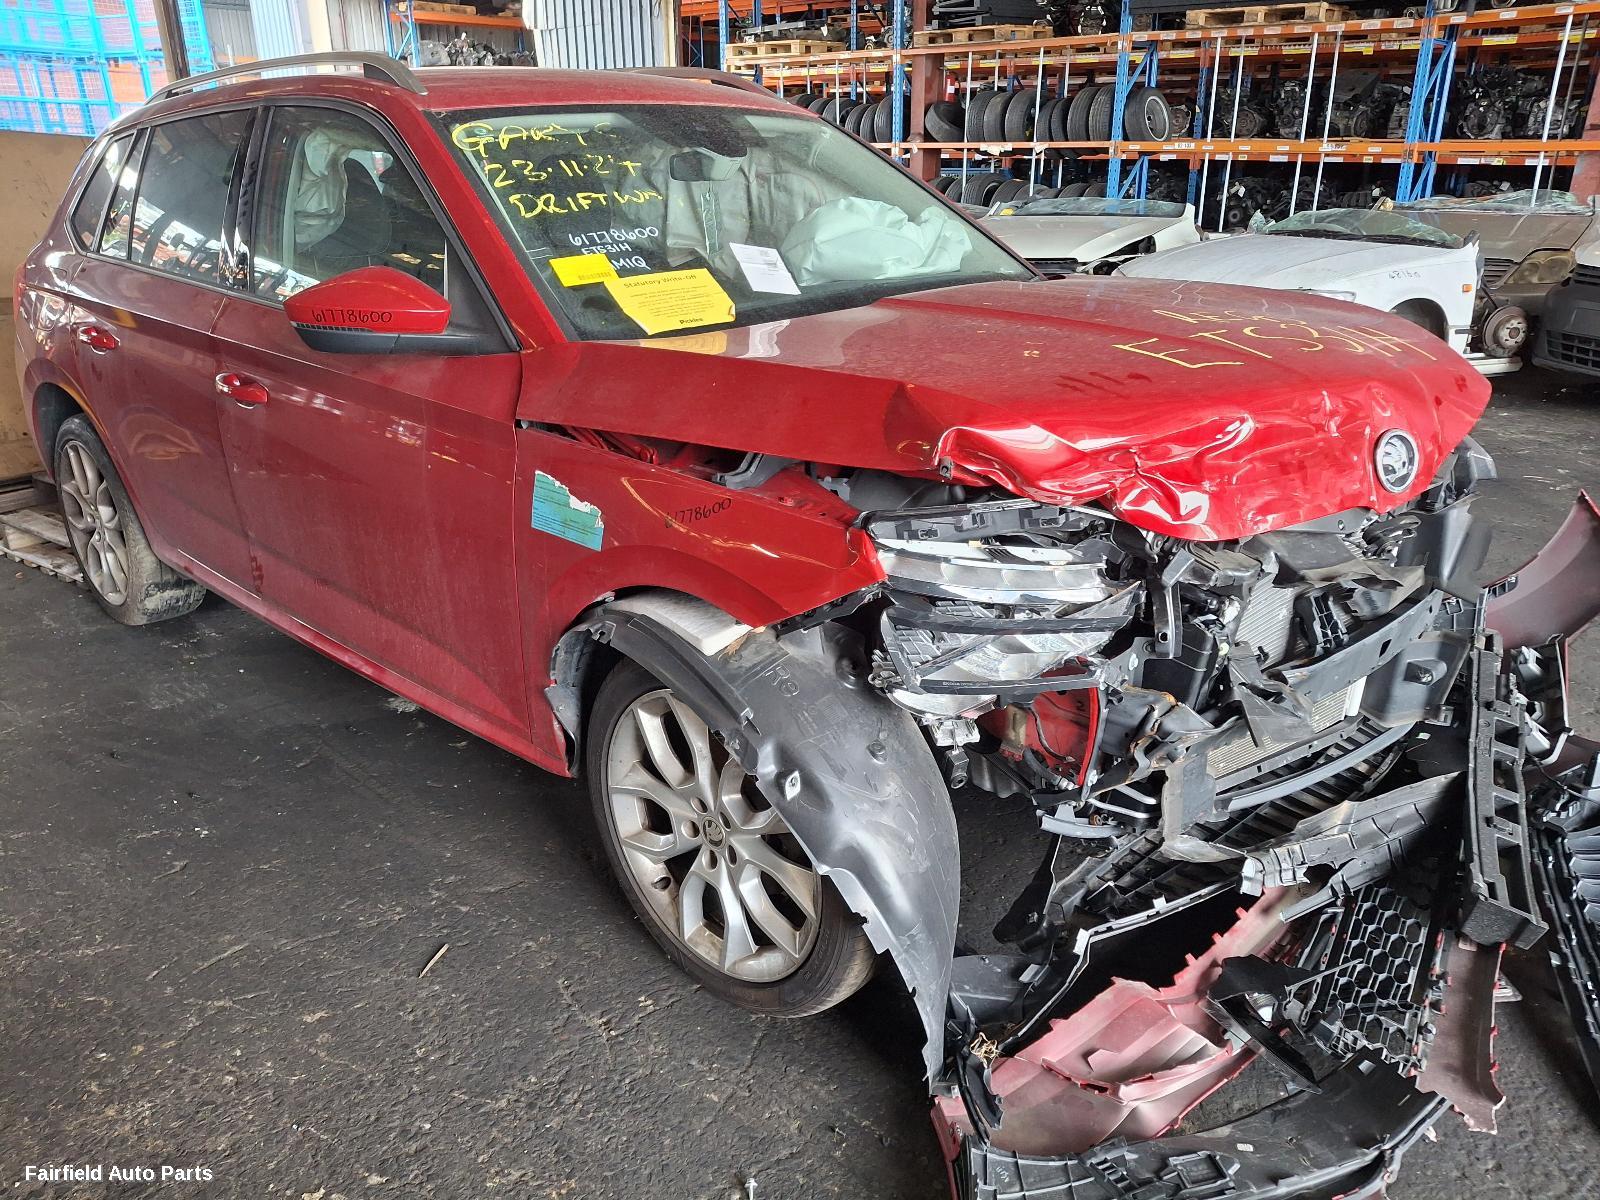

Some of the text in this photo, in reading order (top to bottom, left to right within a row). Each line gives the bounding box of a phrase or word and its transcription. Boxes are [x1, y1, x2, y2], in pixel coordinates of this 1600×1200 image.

[568, 226, 659, 247] 61778600
[312, 308, 393, 324] 61778600
[1111, 323, 1438, 369] ETS31H
